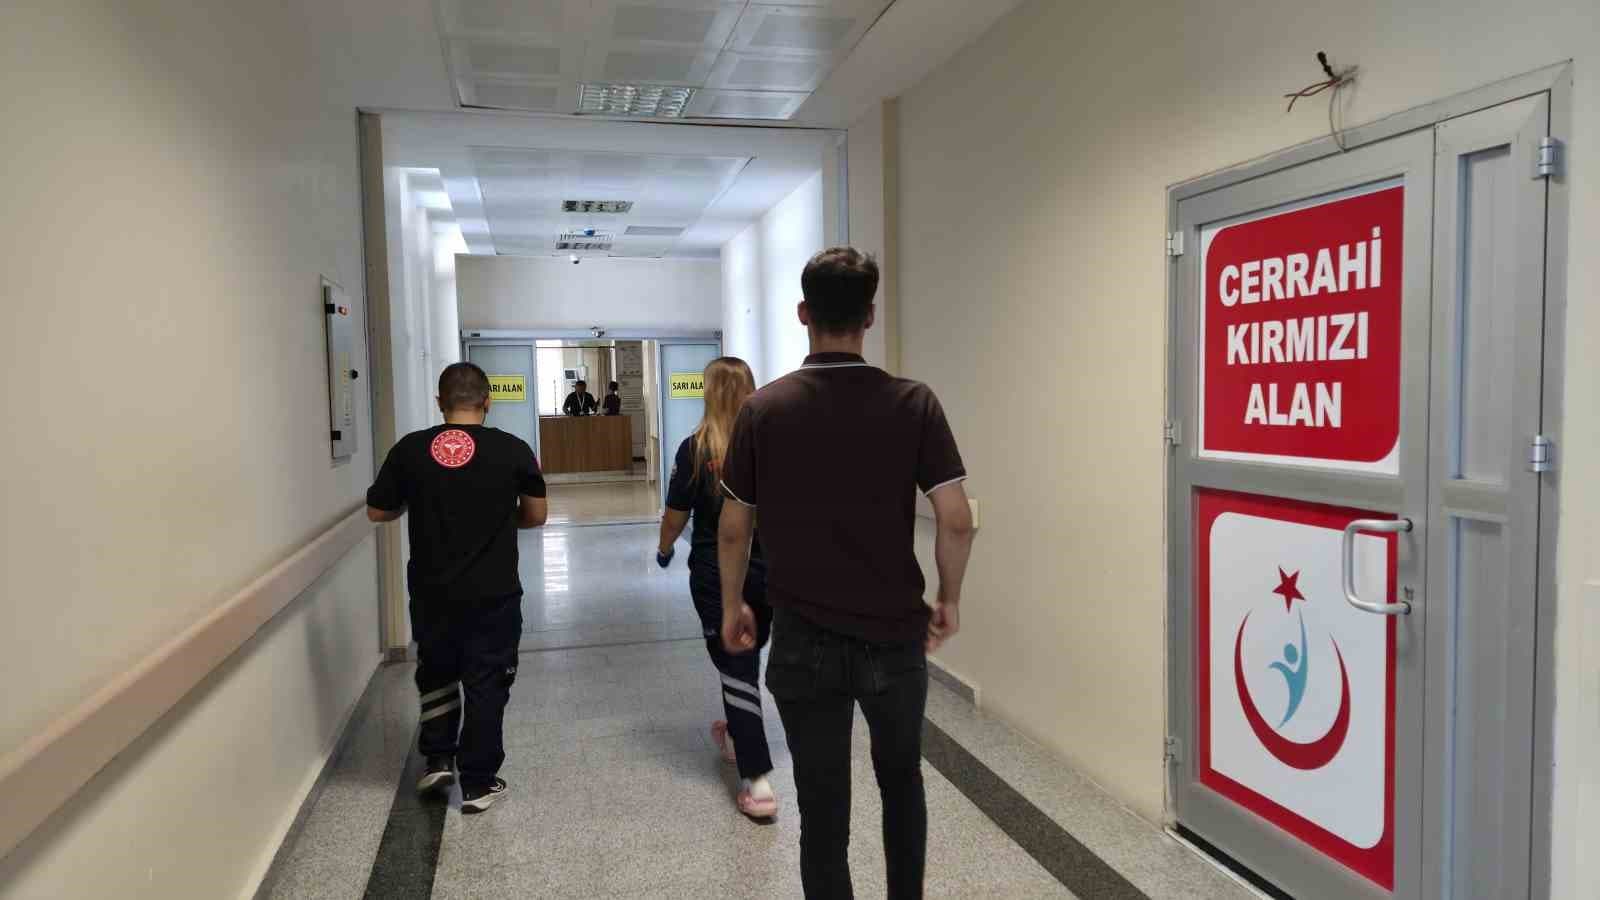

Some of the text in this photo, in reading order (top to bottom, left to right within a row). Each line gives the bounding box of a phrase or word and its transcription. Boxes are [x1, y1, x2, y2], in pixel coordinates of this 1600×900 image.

[1219, 226, 1382, 307] CERRAHİ
[1227, 311, 1368, 365] KIRMIZI
[487, 383, 523, 392] ARI ALAN
[672, 381, 704, 390] SARI ALA
[1244, 381, 1342, 428] ALAN
